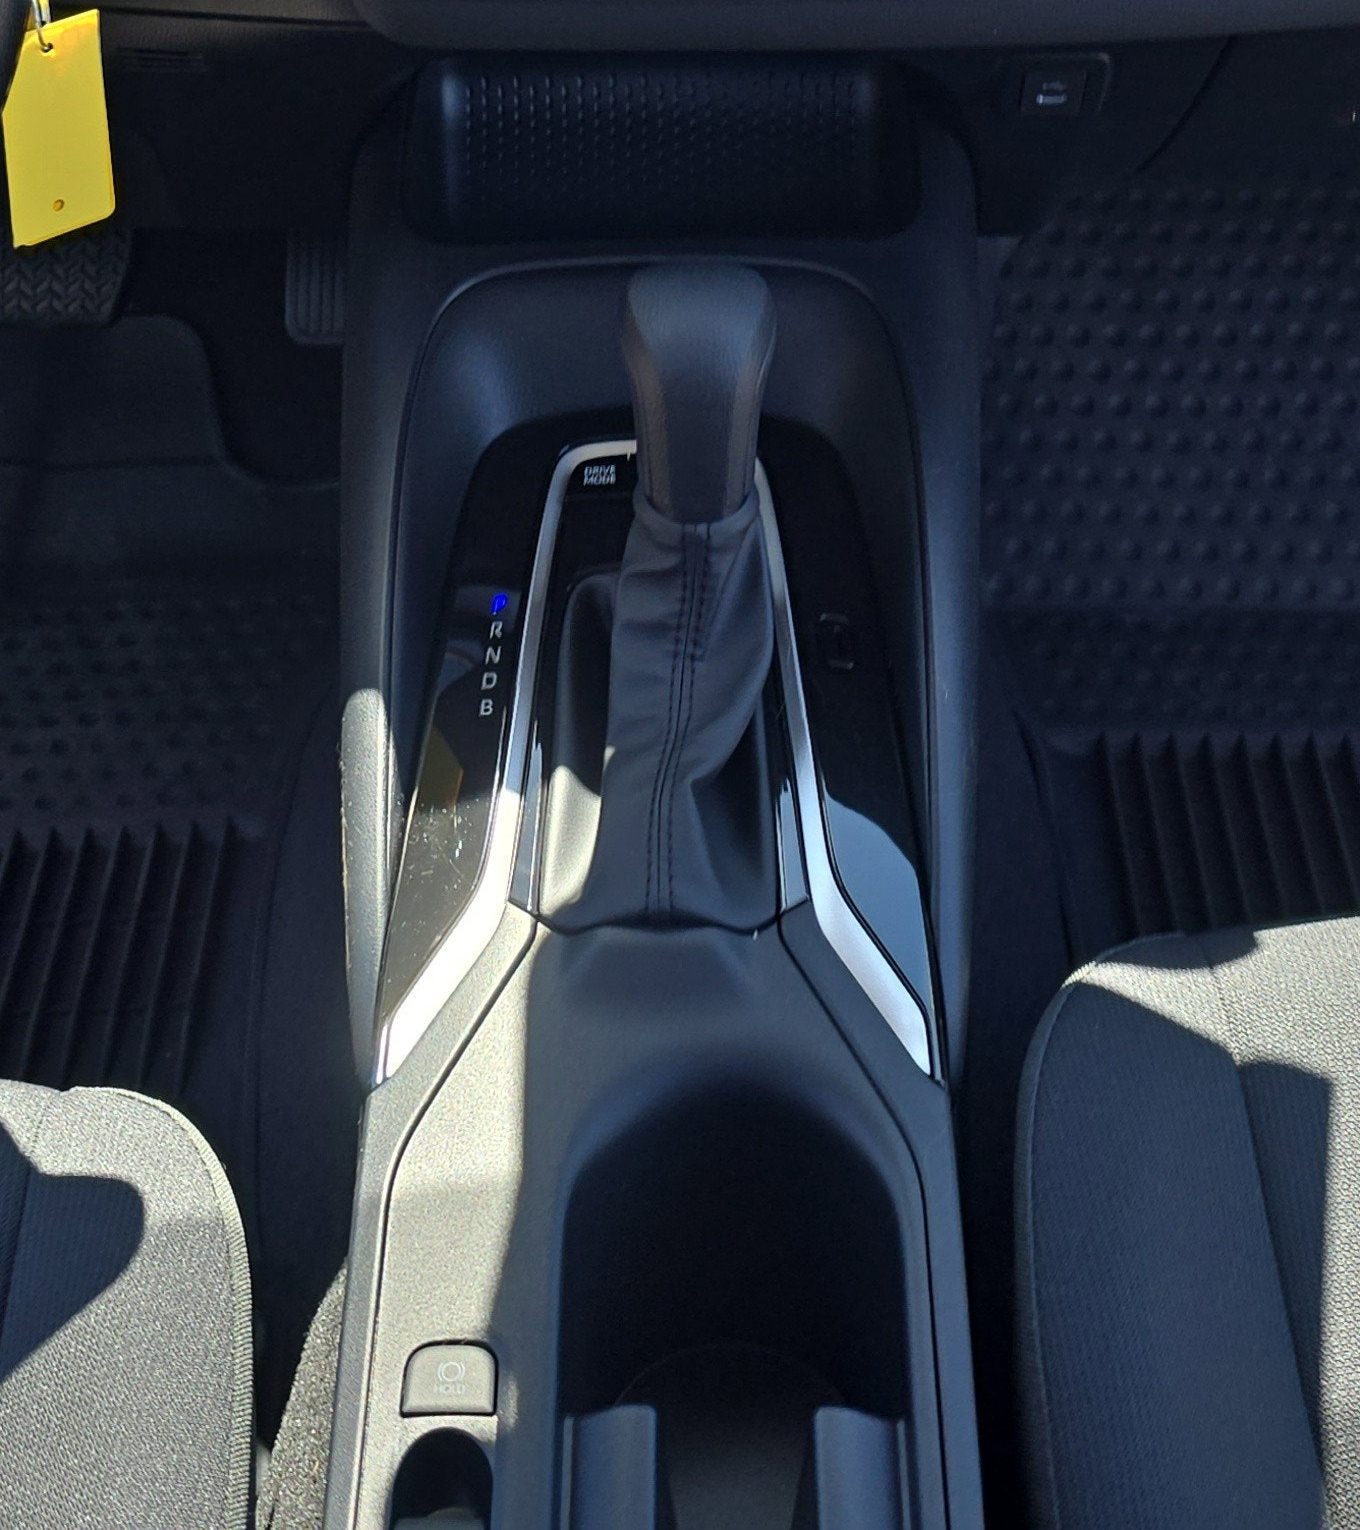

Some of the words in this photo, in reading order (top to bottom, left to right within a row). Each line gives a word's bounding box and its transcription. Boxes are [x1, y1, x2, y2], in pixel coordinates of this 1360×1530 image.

[584, 464, 616, 475] DRIVE
[583, 474, 616, 486] MODE
[490, 592, 508, 615] P
[489, 621, 503, 639] R
[485, 646, 502, 665] N
[481, 672, 498, 690] D
[478, 698, 494, 717] B
